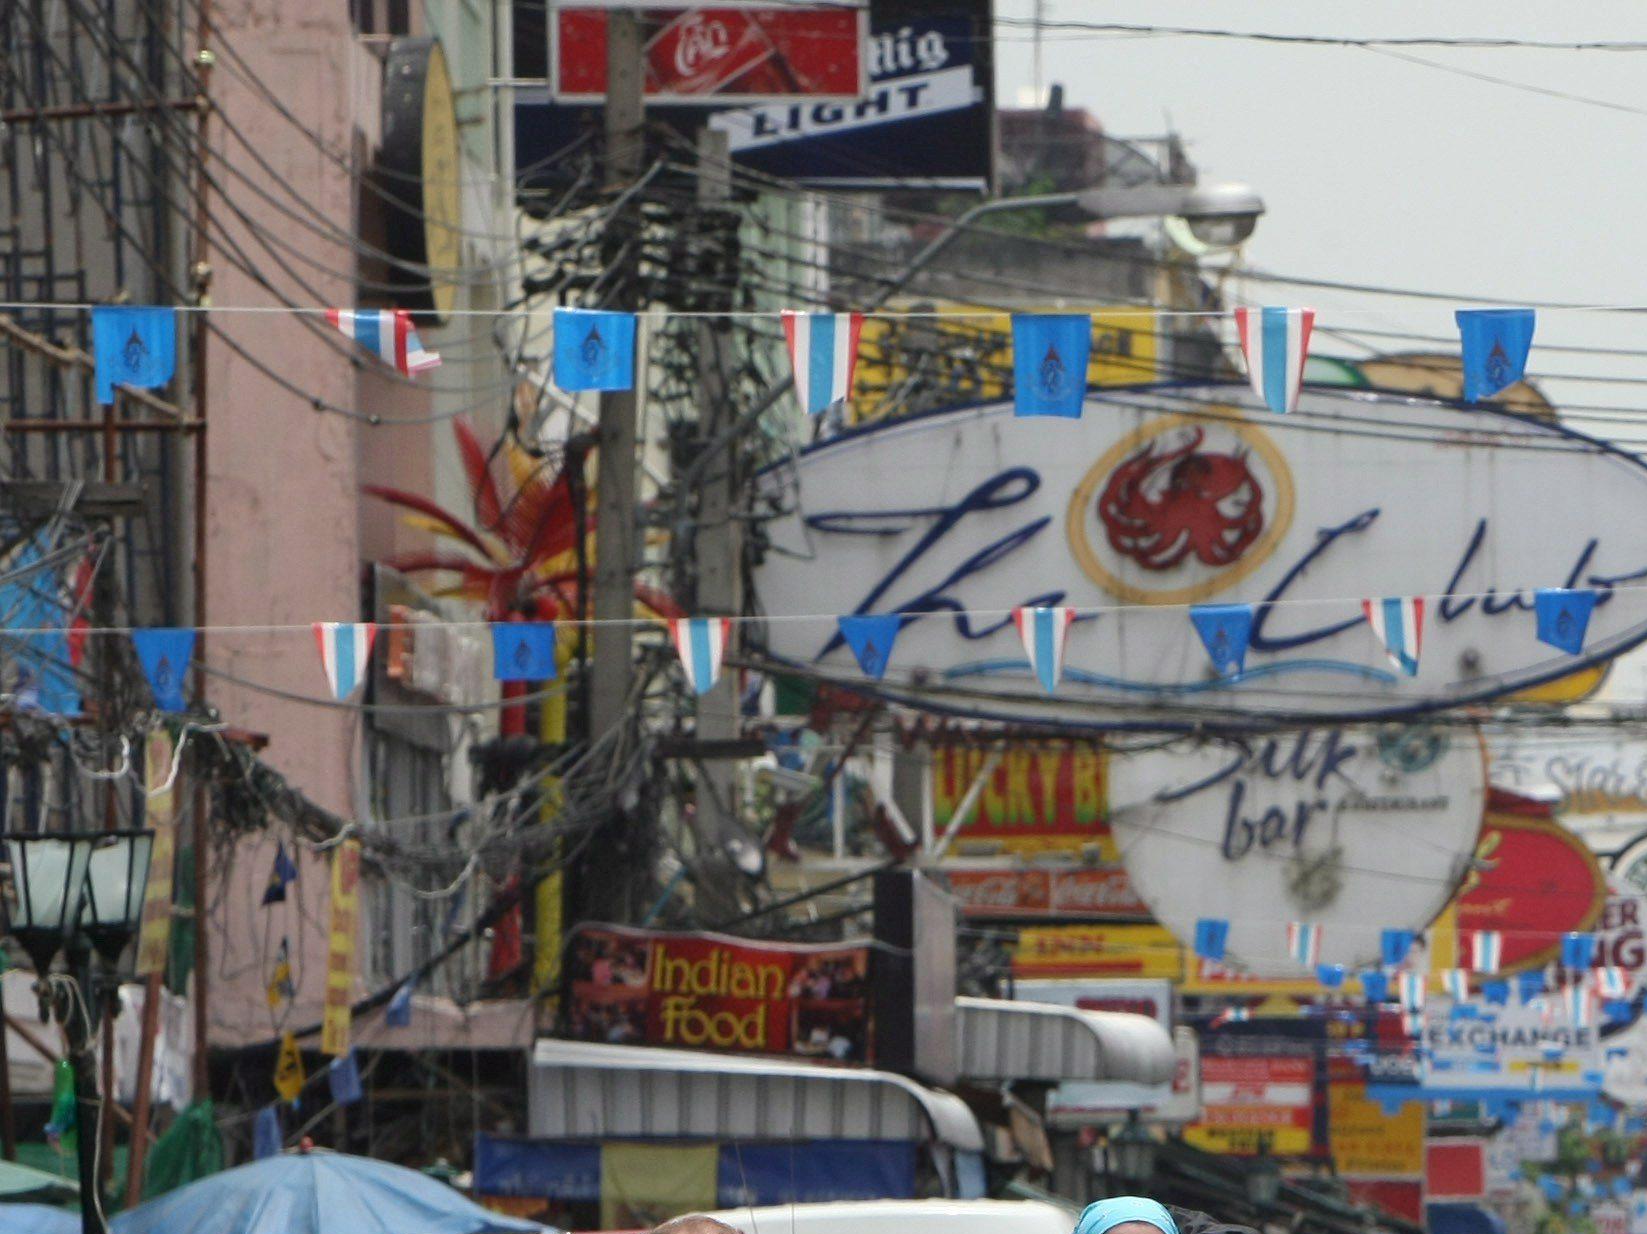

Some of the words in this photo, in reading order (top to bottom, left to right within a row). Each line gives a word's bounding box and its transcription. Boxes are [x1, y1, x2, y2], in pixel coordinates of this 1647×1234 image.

[752, 83, 930, 137] LIGHT
[1223, 779, 1328, 862] bar
[653, 944, 788, 1000] Indian
